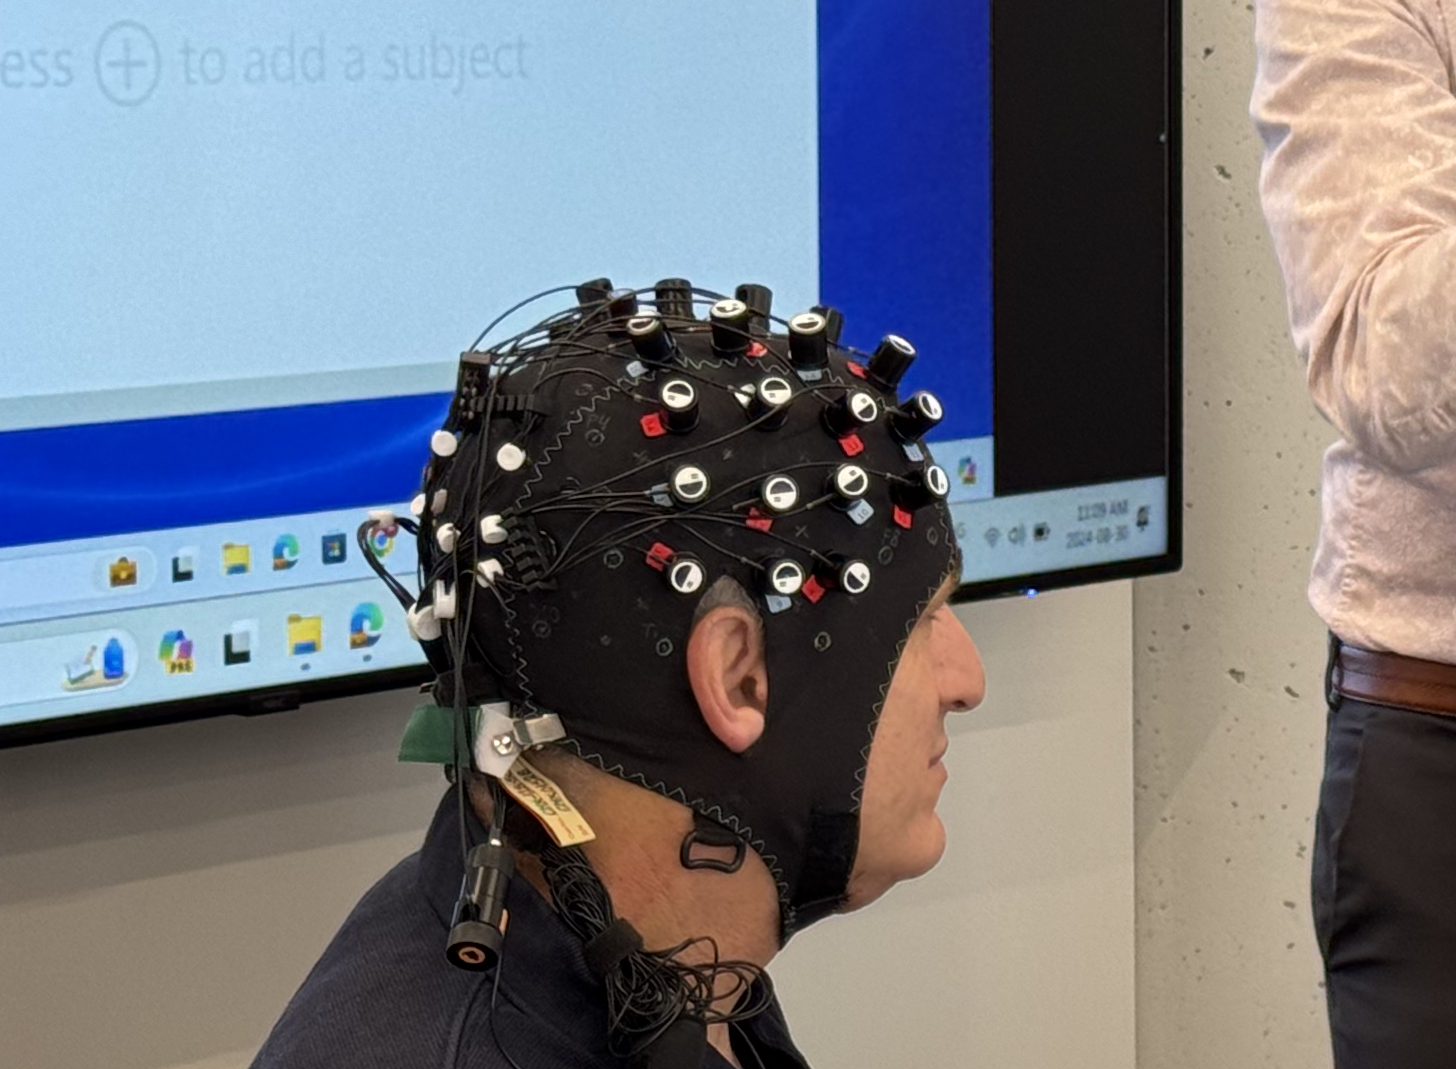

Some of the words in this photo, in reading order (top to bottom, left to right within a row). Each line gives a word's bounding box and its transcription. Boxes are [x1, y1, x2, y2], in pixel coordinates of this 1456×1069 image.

[181, 37, 226, 85] to
[244, 32, 327, 85] add
[344, 43, 366, 83] a
[382, 33, 530, 94] subject
